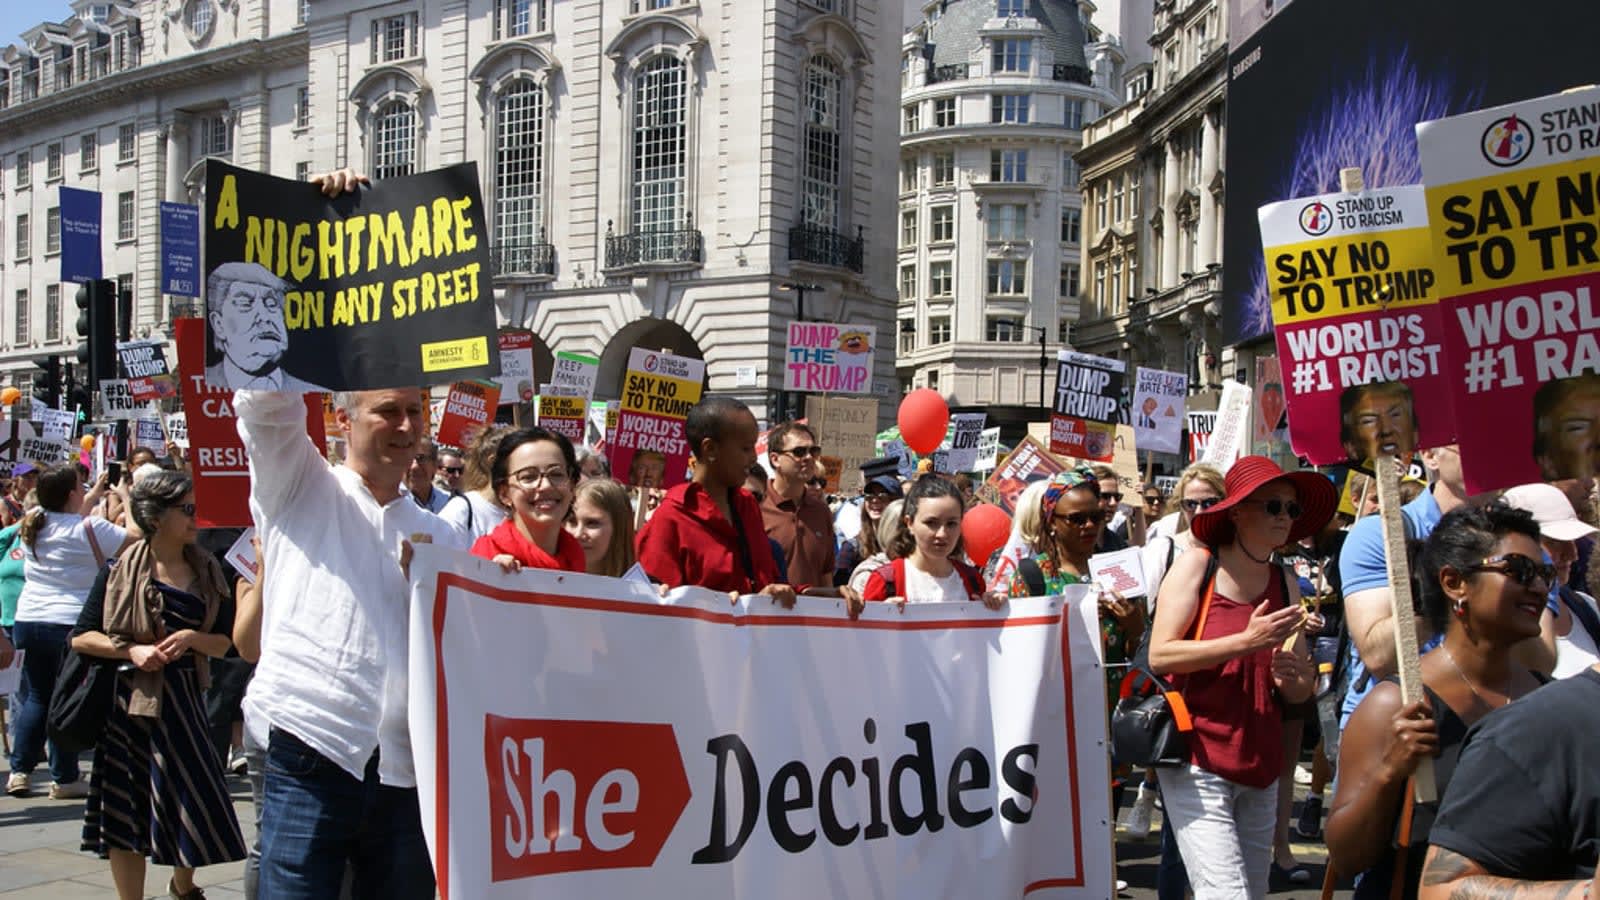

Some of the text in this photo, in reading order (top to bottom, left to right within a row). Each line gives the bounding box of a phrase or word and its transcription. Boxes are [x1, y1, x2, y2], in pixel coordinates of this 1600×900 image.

[1232, 46, 1261, 80] SAMSUNG
[1540, 103, 1600, 133] STAN
[1543, 133, 1573, 156] TO
[215, 174, 239, 230] A
[1336, 196, 1394, 214] STAND UP
[1442, 172, 1600, 239] SAY N
[1338, 210, 1403, 230] TO RACISM
[244, 196, 478, 282] NIGHTMARE
[1276, 240, 1390, 285] SAY NO
[1447, 222, 1600, 285] TO TR
[284, 262, 480, 330] ON ANY STREET
[1279, 268, 1435, 317] TO TRUMP
[1456, 286, 1600, 349] WORL
[790, 323, 840, 348] DUMP
[1285, 313, 1425, 361] WORLD'S
[120, 347, 154, 364] DUMP
[428, 346, 463, 358] AMNESTY
[789, 348, 836, 364] THE
[125, 359, 165, 378] TRUMP
[558, 360, 583, 372] KEEP
[1292, 344, 1441, 395] #1 RACIST
[1464, 344, 1524, 394] #1
[556, 371, 591, 387] FAMILIES
[629, 375, 677, 397] SAY NO
[788, 363, 868, 392] TRUMP
[1059, 364, 1110, 395] DUMP
[1141, 371, 1184, 387] LOVE UA
[105, 383, 130, 396] #DU
[450, 391, 487, 410] CLIMATE
[541, 398, 573, 408] SAY NO
[626, 392, 694, 416] TO TRUMP
[1057, 388, 1117, 421] TRUMP
[447, 402, 488, 423] DISASTER
[541, 406, 553, 416] TO
[556, 407, 584, 417] TRUMP
[169, 420, 186, 429] #DU
[540, 418, 578, 428] WORLD'S
[623, 414, 682, 439] WORLD'S
[957, 419, 983, 431] CHOOSE
[1053, 418, 1075, 431] FIGHT
[1189, 414, 1216, 434] TRU
[169, 430, 187, 440] TRU
[619, 431, 635, 449] #1
[637, 434, 687, 456] RACIST
[952, 431, 981, 450] LOVE
[22, 448, 59, 463] TRUMP
[23, 439, 62, 453] #DUMP
[198, 447, 249, 467] RESI
[502, 717, 1042, 866] She Decides
